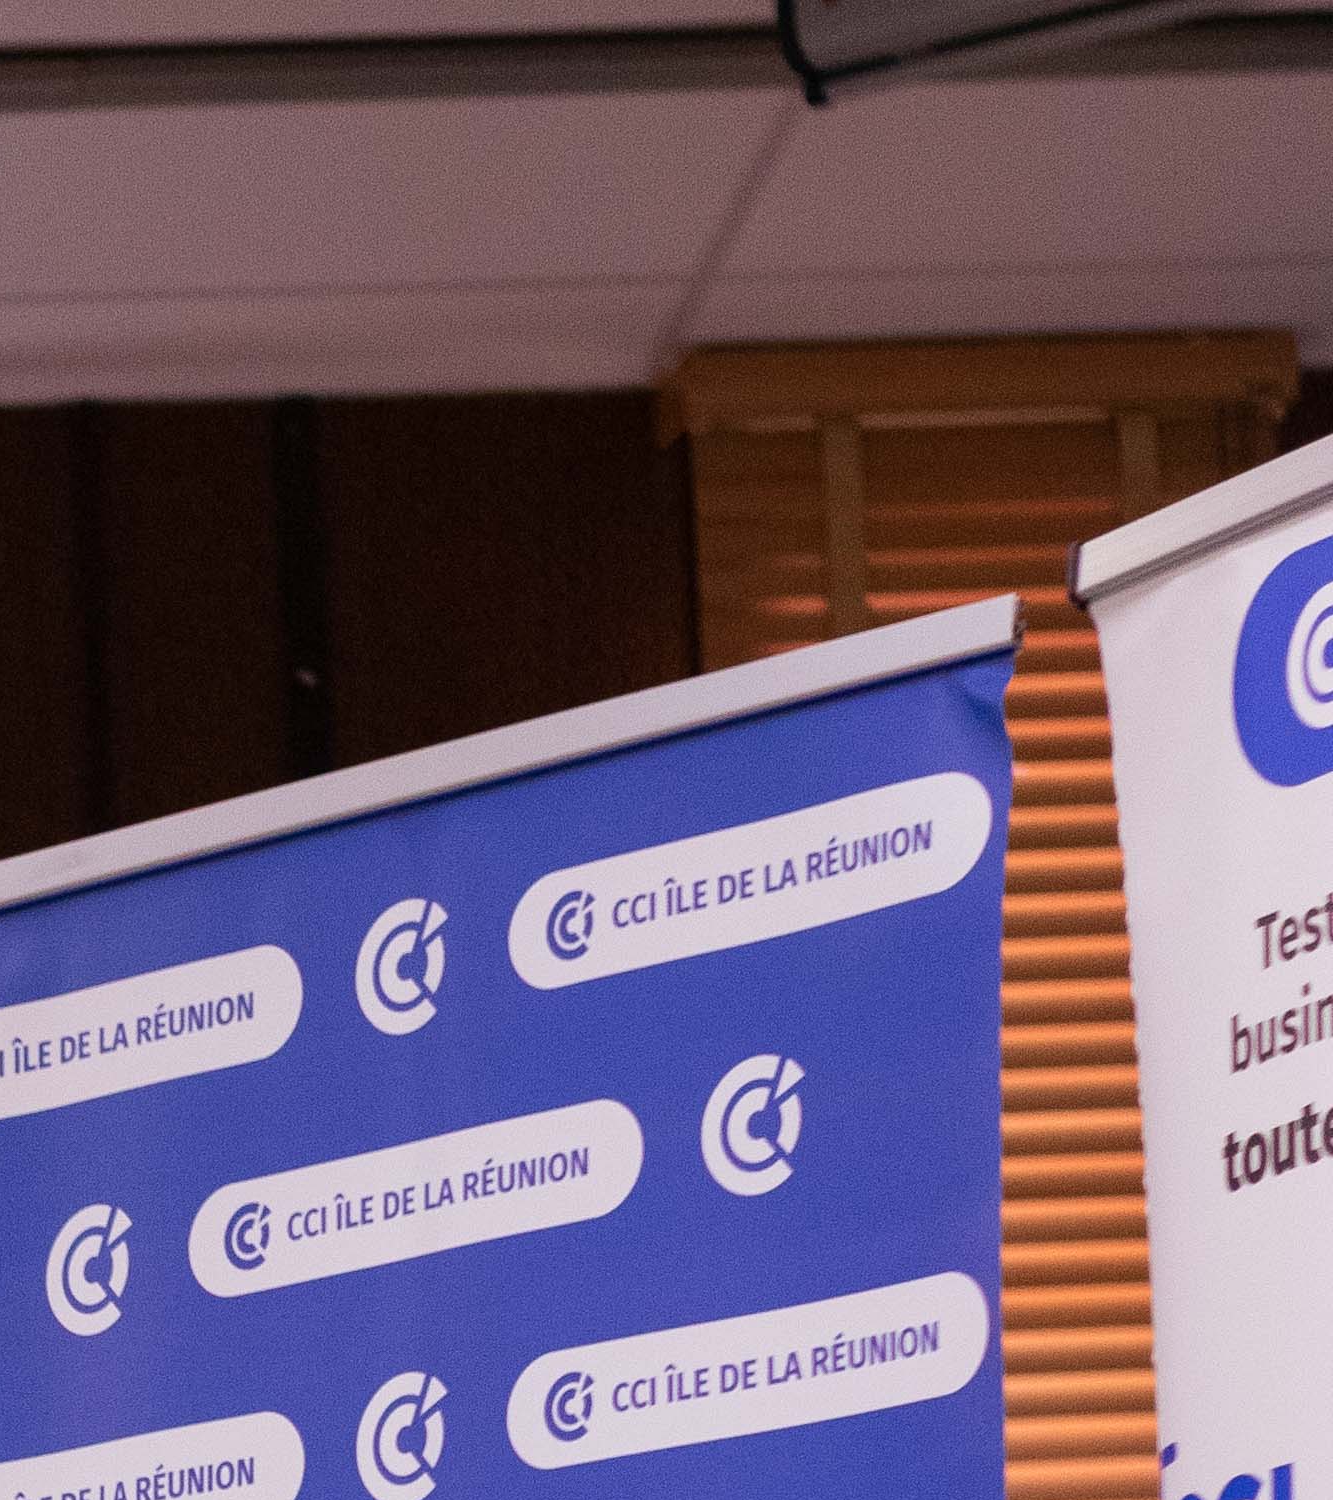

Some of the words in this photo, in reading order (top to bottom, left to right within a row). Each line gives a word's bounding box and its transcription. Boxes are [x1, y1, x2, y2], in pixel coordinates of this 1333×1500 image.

[613, 892, 655, 928] CCI
[665, 878, 707, 916] ÎLE
[718, 869, 754, 904] DE
[764, 859, 797, 893] LA
[807, 822, 931, 882] RÉUNION
[13, 1038, 51, 1074] ÎLE
[60, 1031, 90, 1064] DE
[99, 1023, 128, 1054] LA
[137, 992, 254, 1044] RÉUNION
[287, 1207, 326, 1241] CCI
[335, 1193, 373, 1230] ÎLE
[383, 1186, 415, 1220] DE
[424, 1178, 454, 1210] LA
[463, 1148, 588, 1200] RÉUNION
[613, 1378, 656, 1412] CCI
[666, 1364, 709, 1402] ÎLE
[720, 1359, 756, 1393] DE
[768, 1352, 802, 1385] LA
[812, 1323, 938, 1376] RÉUNION
